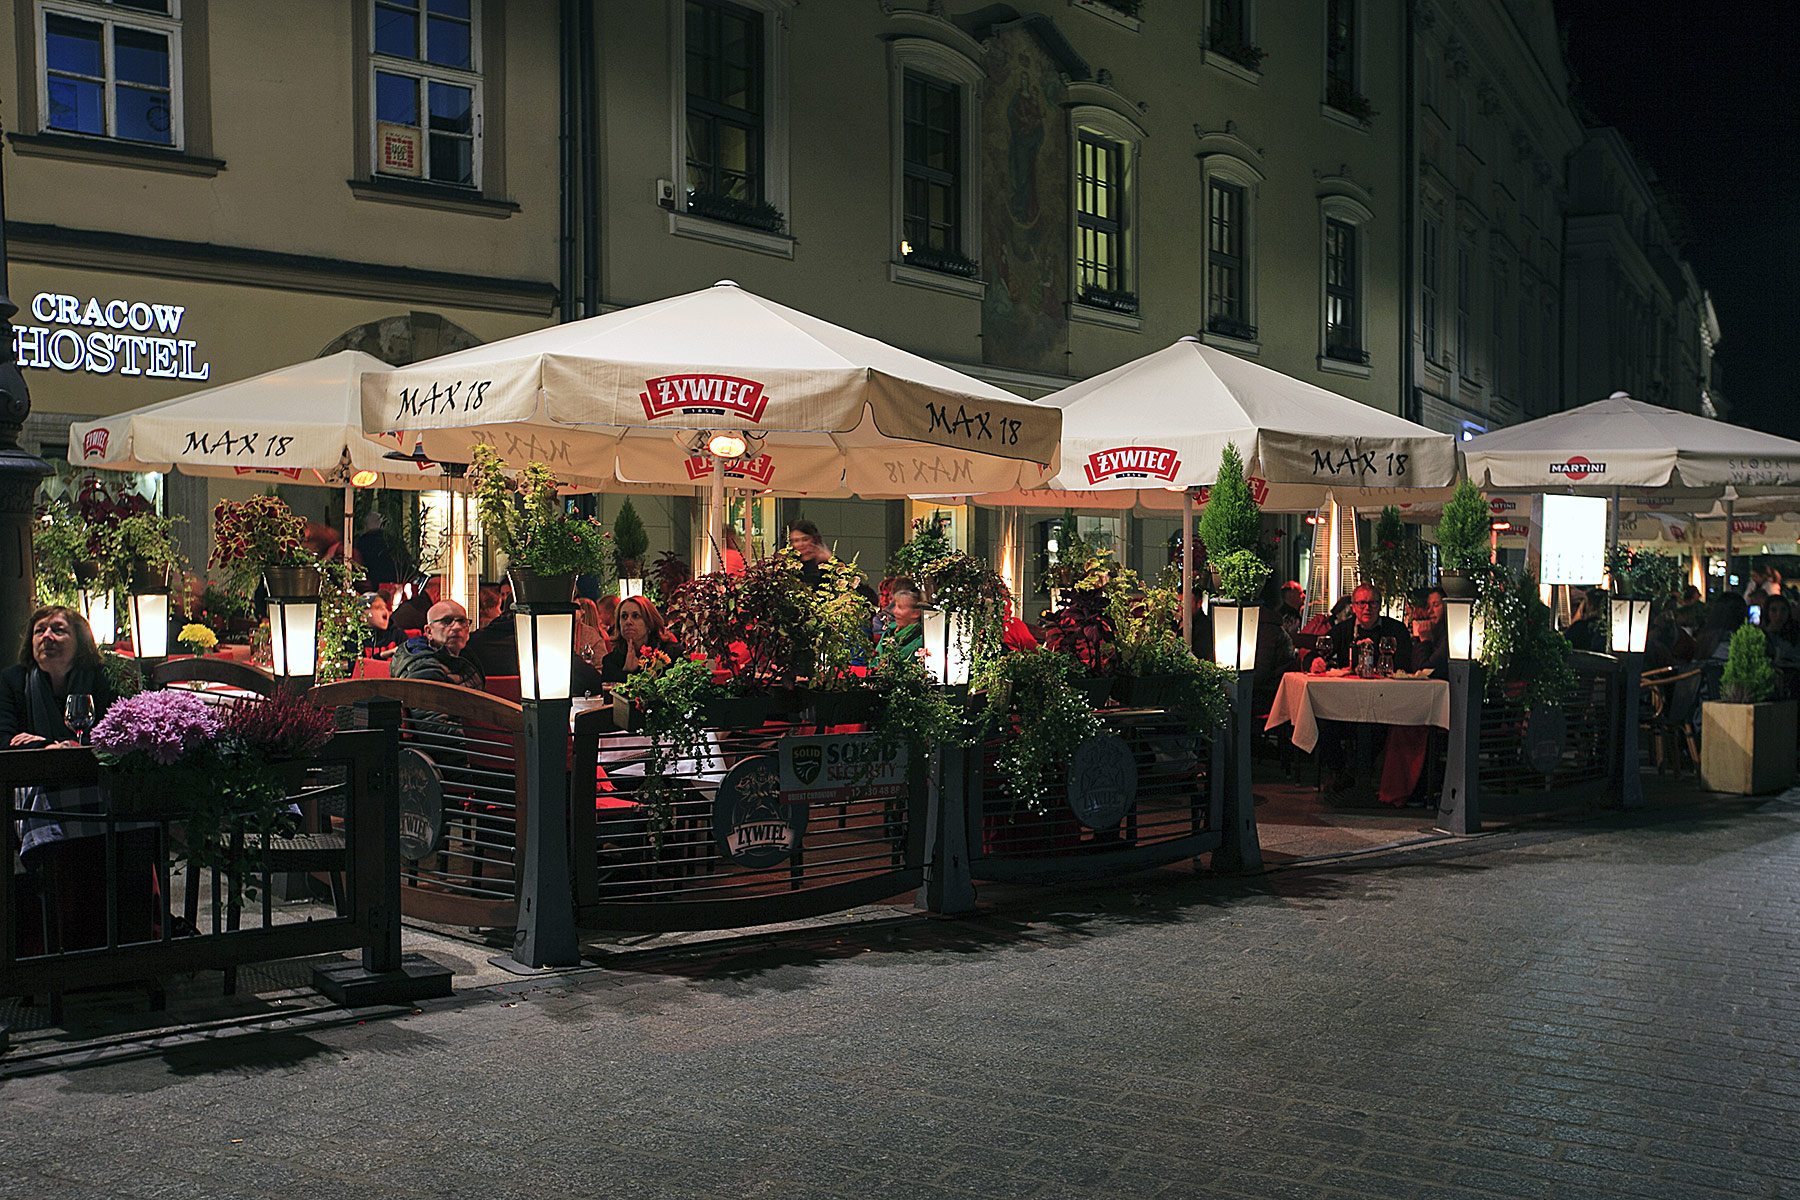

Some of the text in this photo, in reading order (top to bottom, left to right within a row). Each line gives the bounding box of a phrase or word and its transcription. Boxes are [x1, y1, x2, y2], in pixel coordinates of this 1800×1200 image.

[31, 291, 186, 334] CRACOW
[12, 324, 210, 381] HOSTEL
[395, 380, 492, 421] MAX 18
[657, 377, 755, 407] ŻYWIEC
[925, 401, 1022, 446] MAX 18
[181, 430, 294, 457] MAX 18
[1096, 450, 1171, 474] ŻYWIEC
[1310, 447, 1409, 476] MAX 18
[1551, 464, 1605, 473] MARTINI
[1489, 502, 1515, 510] ARTINI
[793, 748, 821, 759] SOLID
